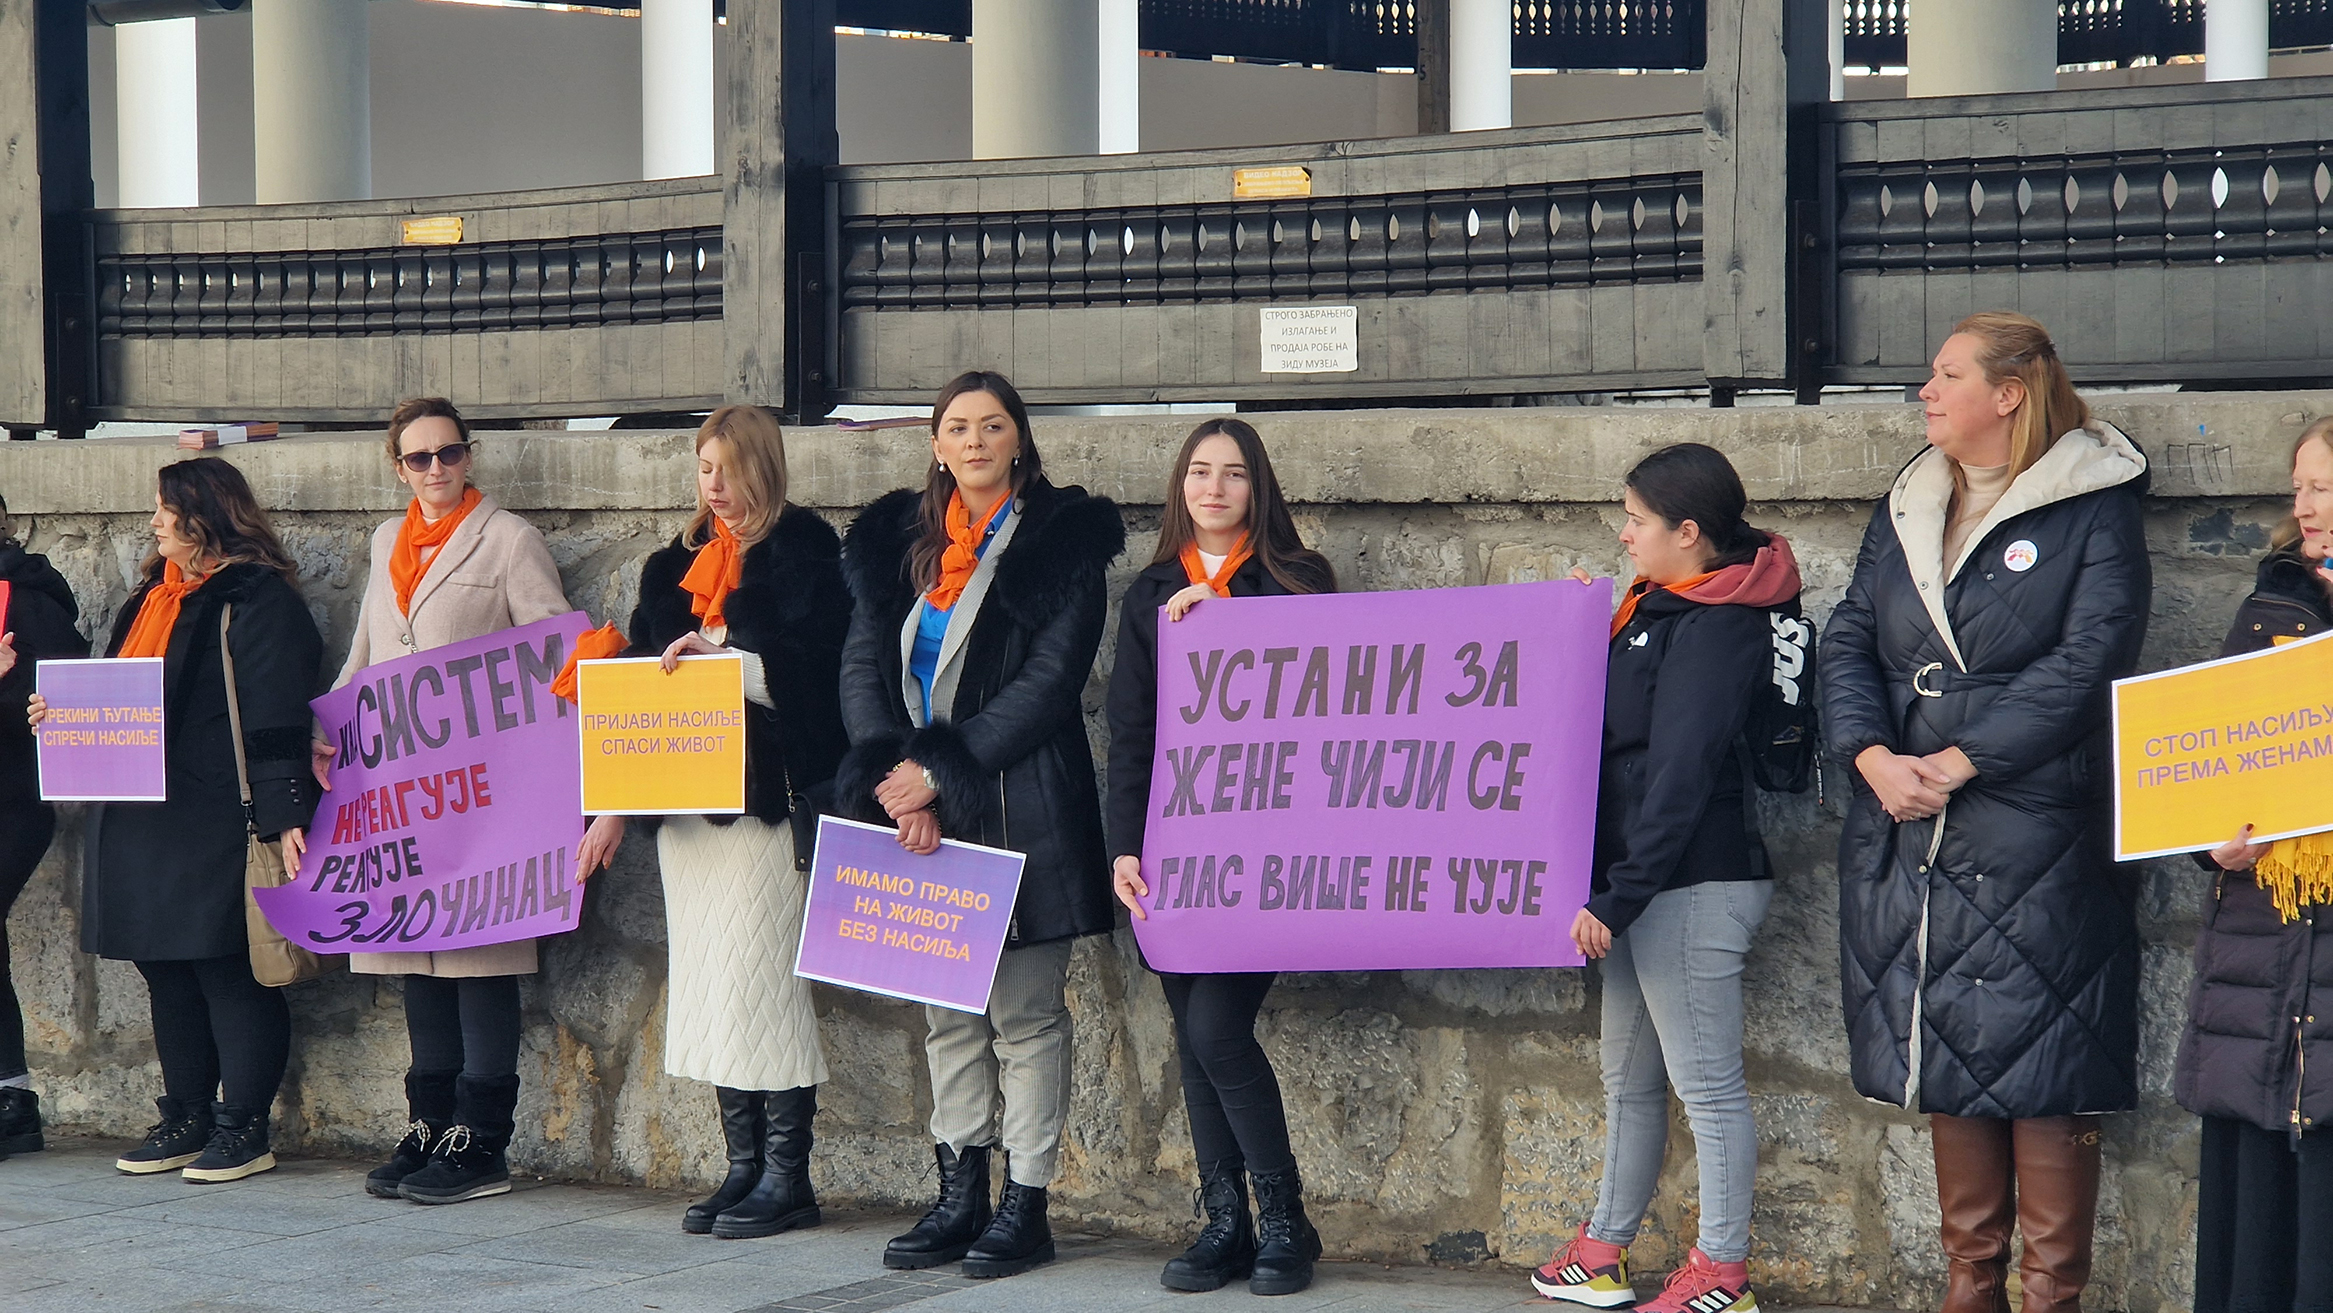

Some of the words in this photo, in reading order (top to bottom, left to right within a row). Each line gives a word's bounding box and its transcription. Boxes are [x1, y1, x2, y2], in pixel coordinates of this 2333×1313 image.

[1265, 310, 1298, 320] СТРОГО
[1299, 309, 1353, 319] ЗАБРАЊЕНО
[1282, 326, 1328, 336] ИЗЛАГАЊЕ
[1330, 326, 1337, 334] И
[1270, 343, 1309, 353] ПРОДАЈА
[1311, 342, 1334, 352] РОБЕ
[1336, 342, 1348, 350] НА
[1281, 360, 1304, 370] ЗИДУ
[1305, 359, 1338, 368] МУЗЕЈА
[1178, 643, 1426, 725] УСТАНИ
[1444, 640, 1519, 708] ЗА
[102, 706, 162, 723] ЋУТАЊЕ
[356, 632, 568, 770] СИСТЕМ
[44, 730, 96, 746] СПРЕЧИ
[99, 730, 158, 746] НАСИЉЕ
[584, 712, 662, 730] ПРИЈАВИ
[668, 710, 742, 728] НАСИЉЕ
[602, 738, 660, 756] СПАСИ
[666, 736, 726, 754] ЖИВОТ
[2138, 757, 2230, 788] ПРЕМА
[2236, 734, 2333, 773] ЖЕНАМ
[2145, 728, 2217, 758] СТОП
[1162, 740, 1299, 818] ЖЕНЕ
[1320, 739, 1456, 812] ЧИЈИ
[1467, 740, 1532, 811] СЕ
[309, 836, 423, 893] РЕАГУЈЕ
[308, 846, 572, 943] ЗЛОЧИНАЦ
[836, 864, 914, 896] ИМАМО
[920, 882, 990, 912] ПРАВО
[1153, 854, 1244, 911] ГЛАС
[1259, 854, 1372, 911] ВИШЕ
[1384, 856, 1431, 912] НЕ
[1447, 857, 1548, 917] ЧУЈЕ
[854, 896, 882, 918] НА
[887, 902, 963, 932] ЖИВОТ
[838, 918, 878, 942] БЕЗ
[882, 928, 970, 962] НАСИЉА
